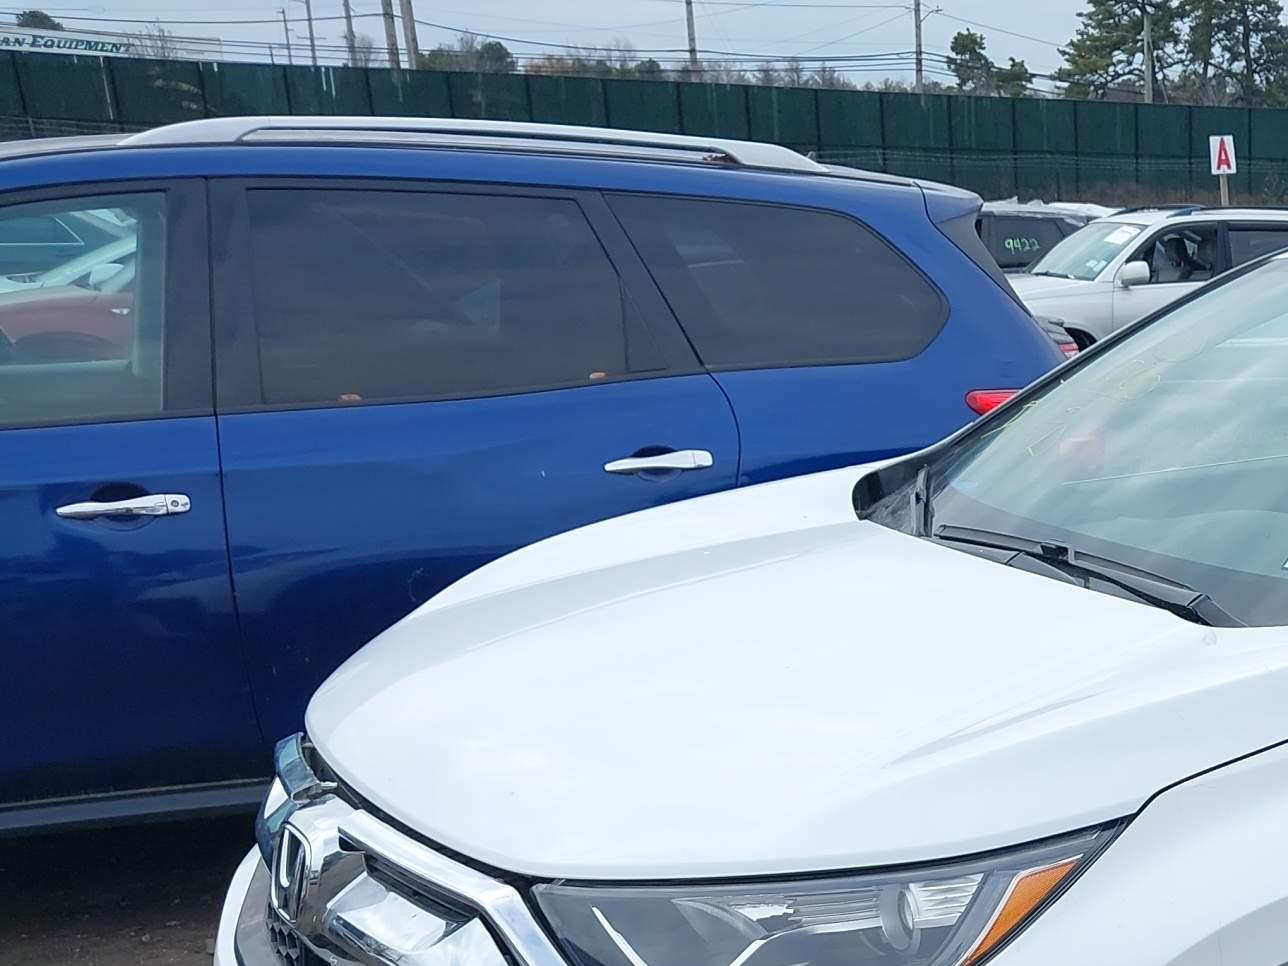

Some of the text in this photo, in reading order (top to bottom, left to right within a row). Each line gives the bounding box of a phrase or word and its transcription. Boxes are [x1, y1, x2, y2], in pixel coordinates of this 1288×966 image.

[31, 34, 134, 53] EQUIPMENT
[1216, 136, 1232, 170] A
[1004, 238, 1040, 255] 9422
